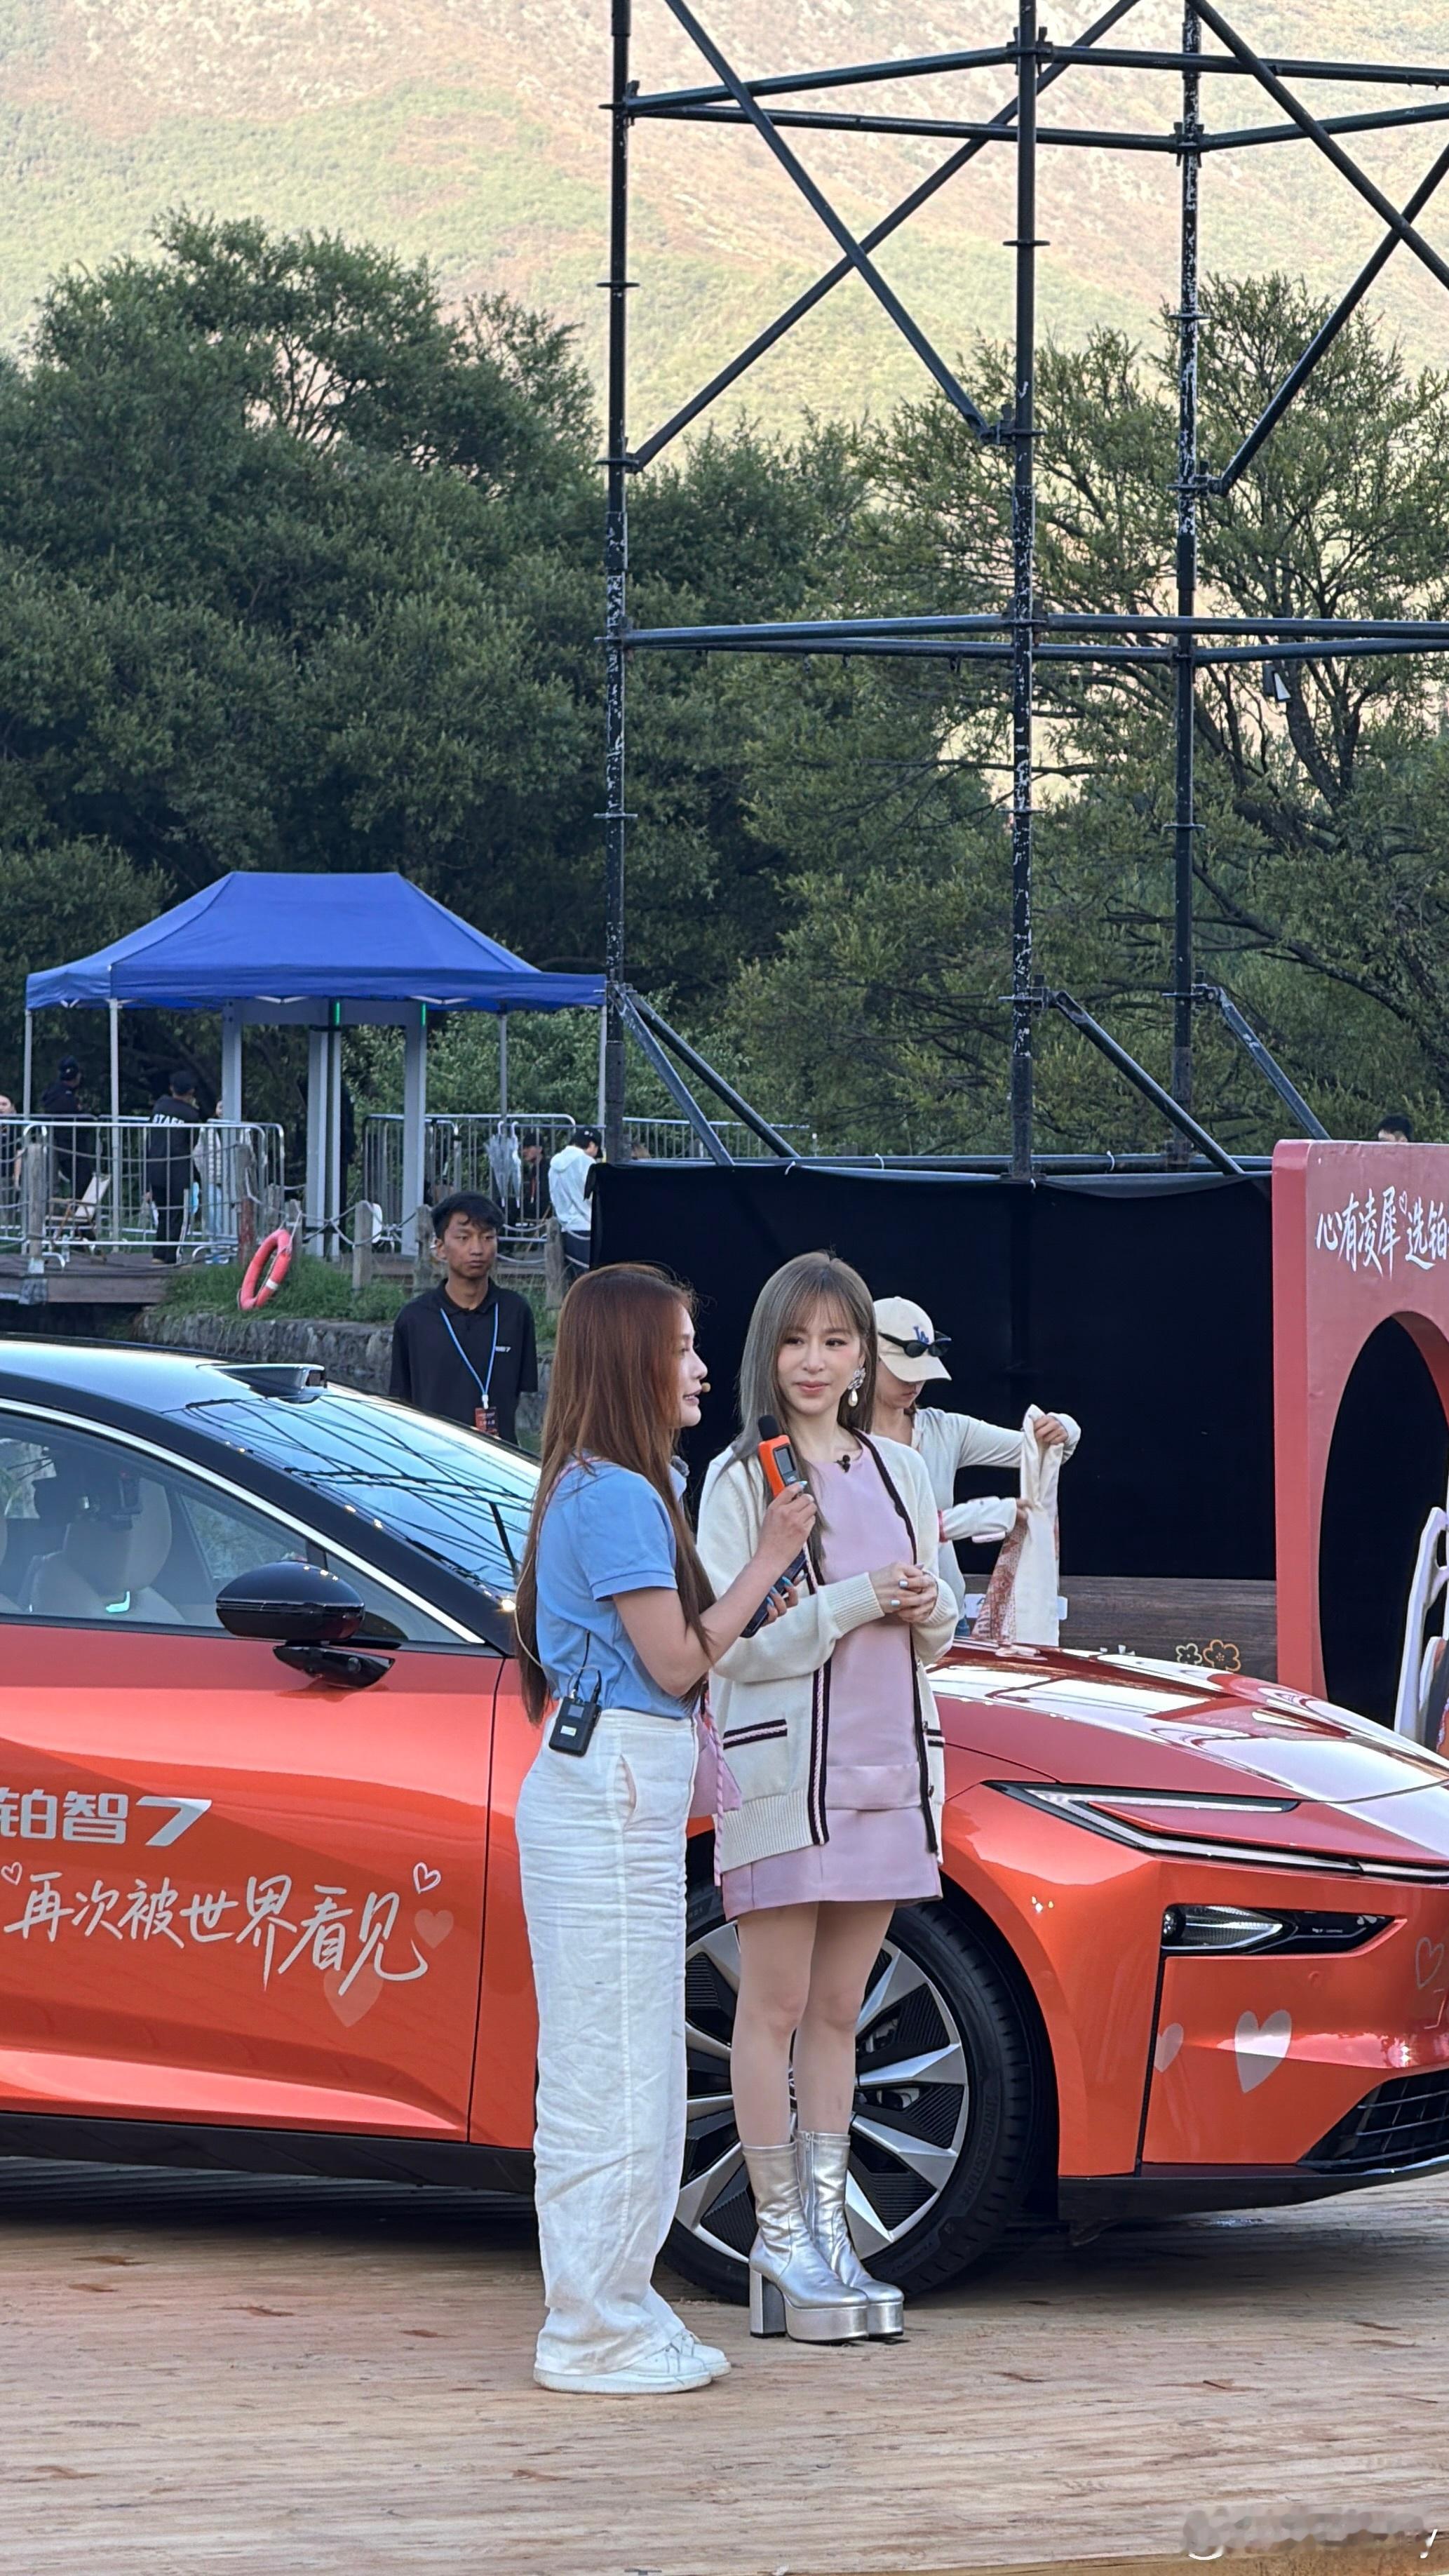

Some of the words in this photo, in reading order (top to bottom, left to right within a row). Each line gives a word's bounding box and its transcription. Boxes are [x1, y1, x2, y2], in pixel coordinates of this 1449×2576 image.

[0, 1787, 212, 1846] 铂智7
[4, 1871, 428, 1996] 再次被世界看见
